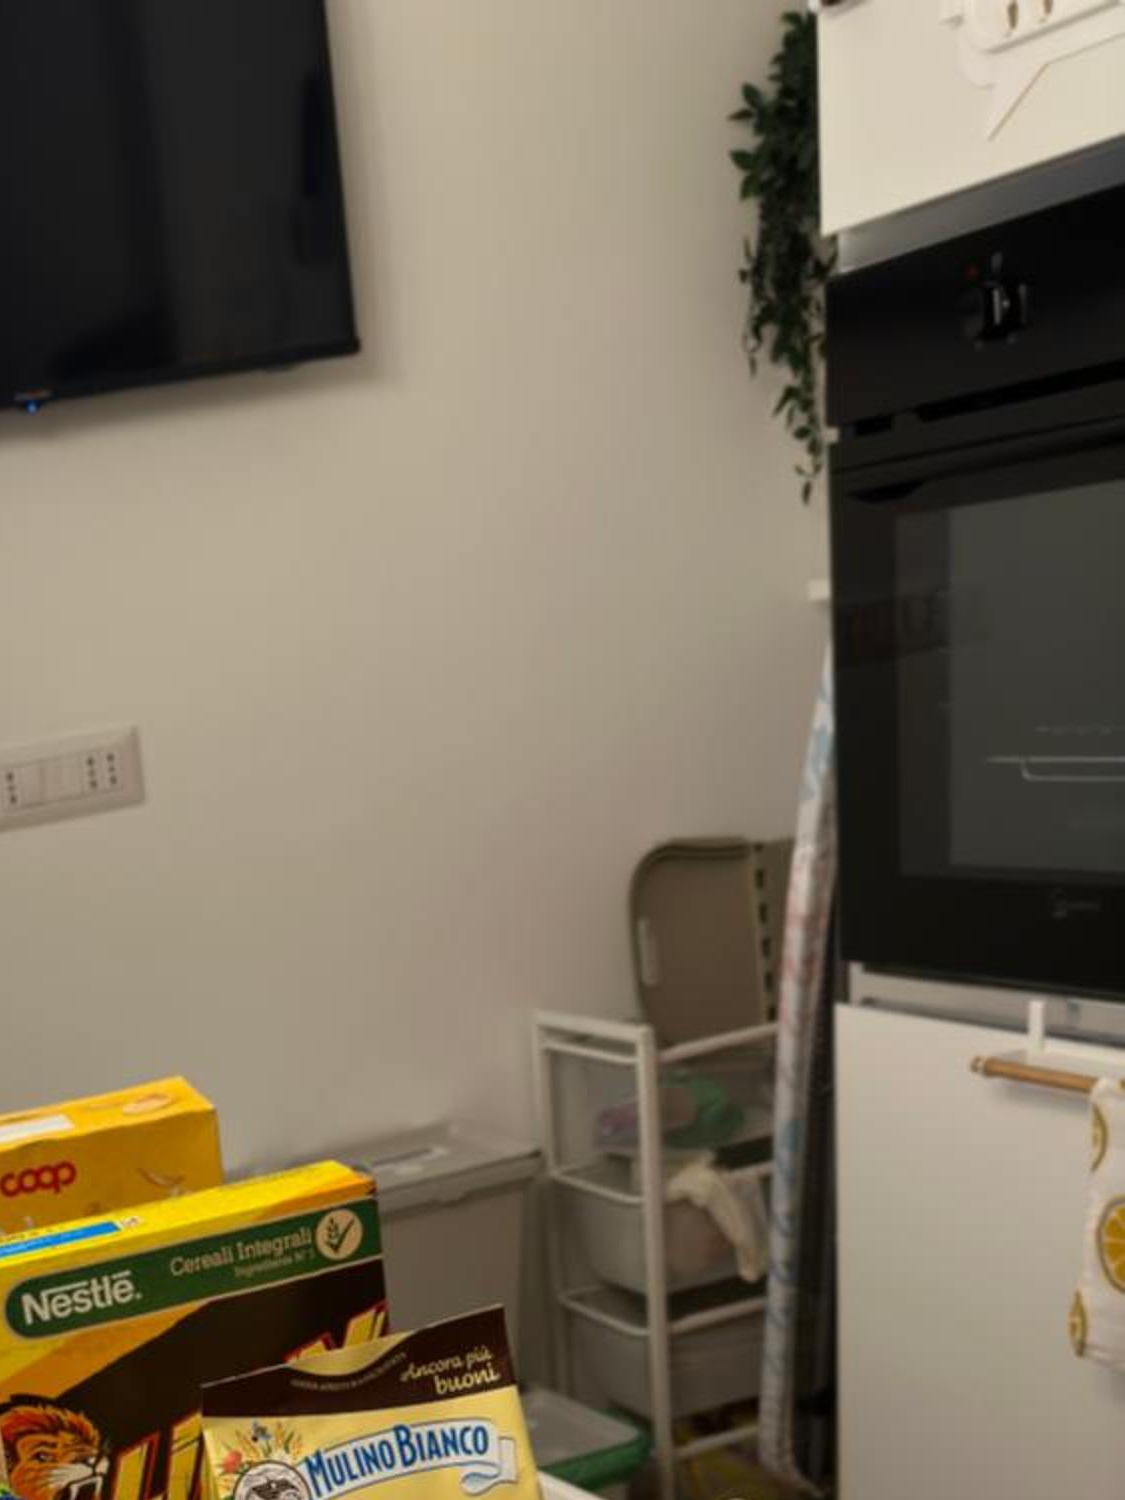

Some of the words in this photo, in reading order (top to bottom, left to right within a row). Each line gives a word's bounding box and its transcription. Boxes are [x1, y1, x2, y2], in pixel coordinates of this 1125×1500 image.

[170, 1250, 235, 1277] Cereali
[237, 1228, 312, 1263] Integrali
[21, 1271, 137, 1325] Nestlé
[399, 1356, 463, 1383] Ancora
[434, 1360, 502, 1395] buoni
[305, 1438, 395, 1498] MULINO
[392, 1424, 490, 1468] BIANCO
